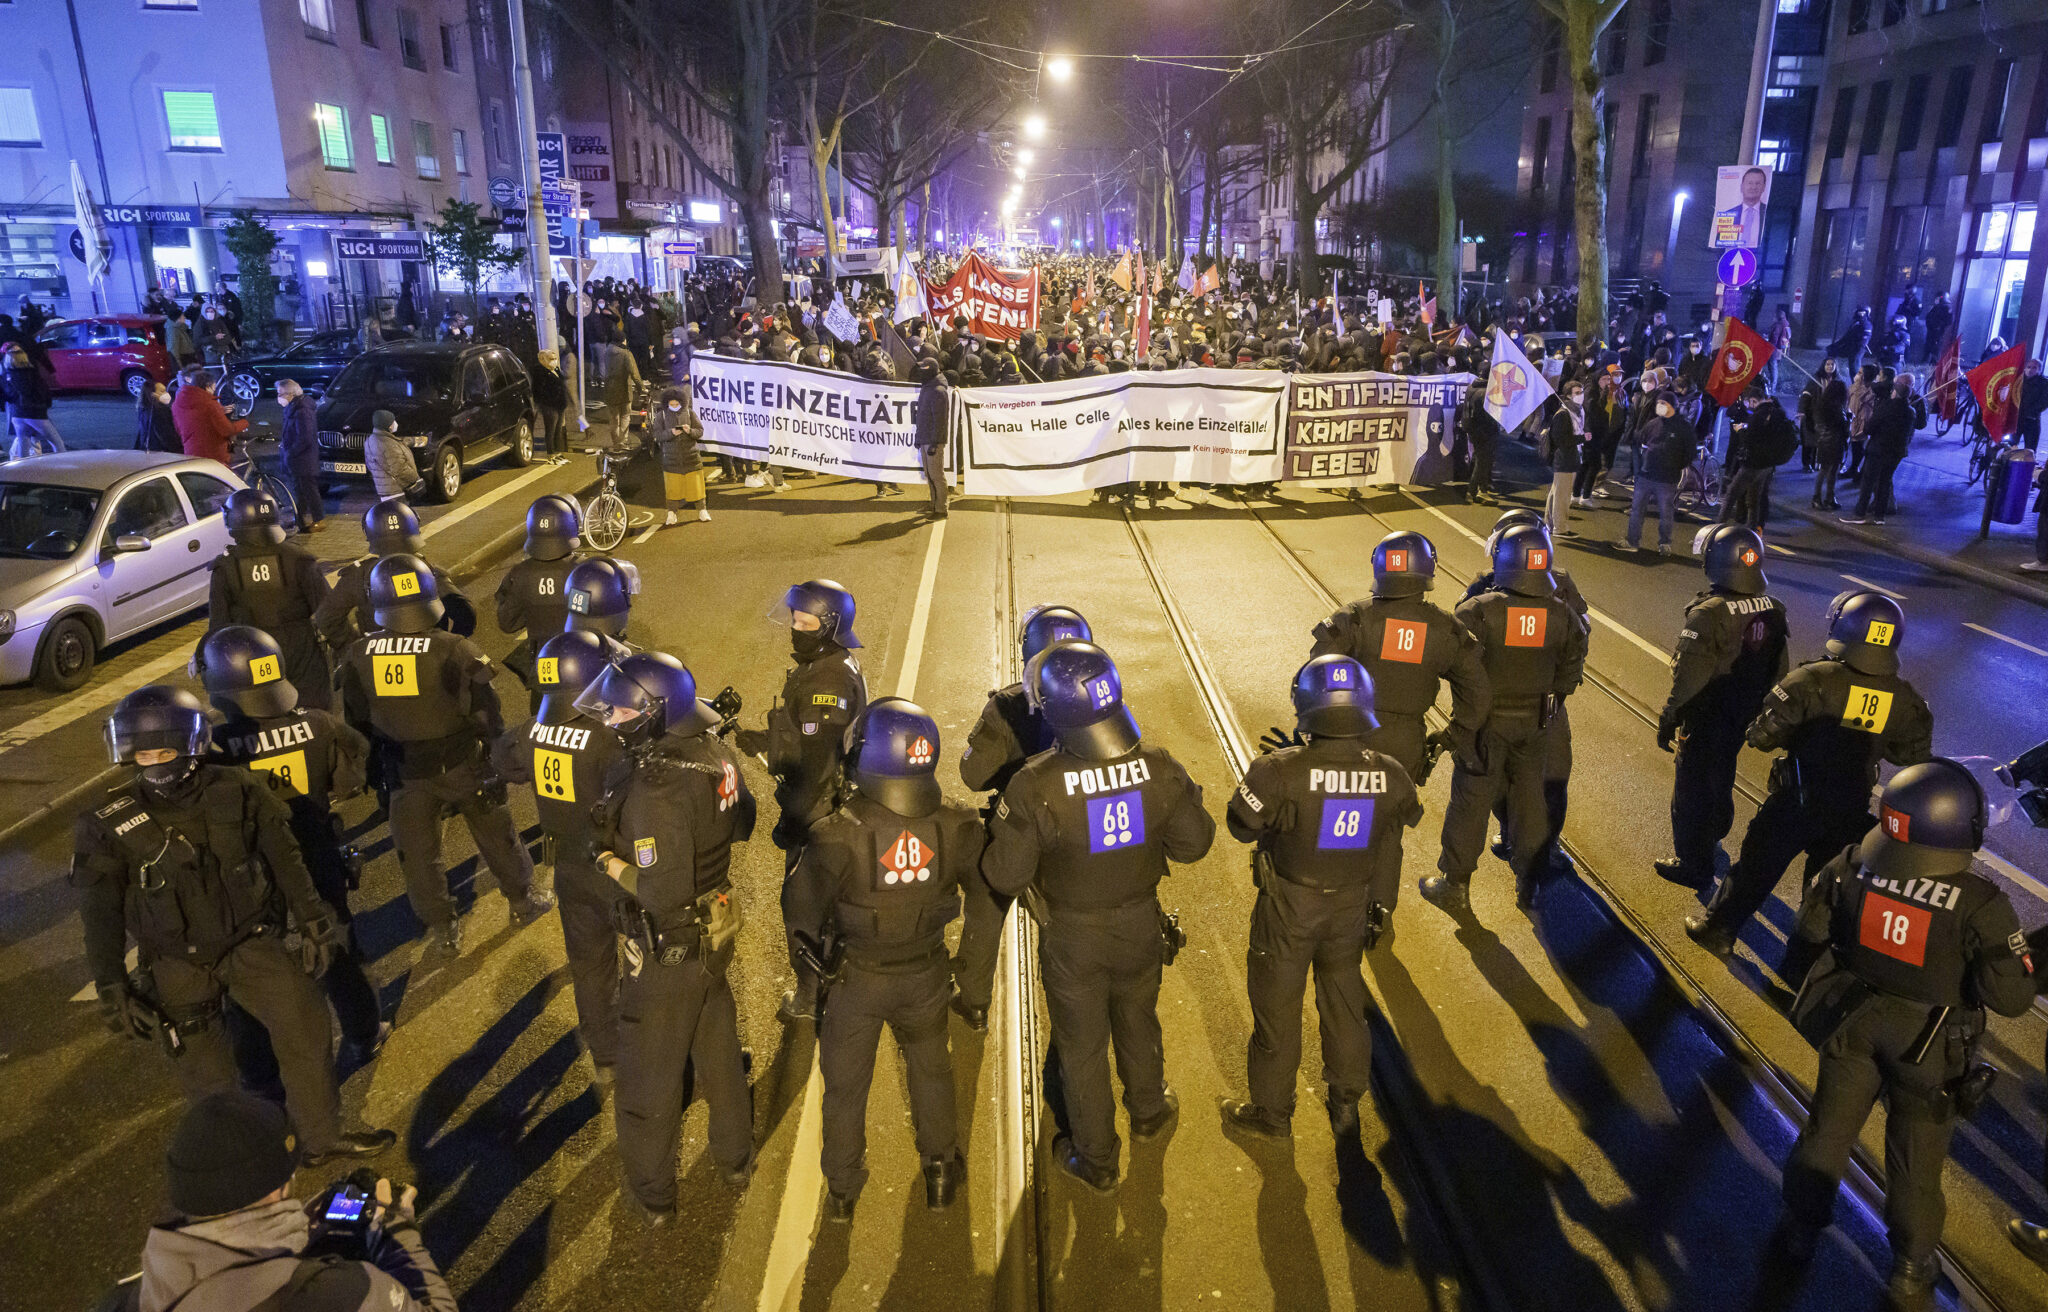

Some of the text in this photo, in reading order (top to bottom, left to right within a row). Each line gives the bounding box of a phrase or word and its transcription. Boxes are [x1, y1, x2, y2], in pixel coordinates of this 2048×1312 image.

[540, 158, 560, 192] BAR
[104, 208, 191, 222] RICH SPORTSBAR
[504, 215, 525, 227] sky
[341, 242, 419, 255] RICH SPORTSBAR
[933, 286, 964, 310] ALS
[693, 374, 755, 407] KEINE
[999, 400, 1036, 410] Vergeben
[700, 407, 737, 425] RECHTER
[772, 415, 790, 431] IST
[792, 419, 856, 442] DEUTSCHE
[978, 409, 1268, 434] Hanau Halle Celle Alles keine Einzelfälle!
[1296, 417, 1406, 445] KÄMPFEN
[792, 448, 839, 466] Frankfurt
[1193, 444, 1211, 452] Kein
[1293, 449, 1378, 477] LEBEN
[260, 504, 270, 514] 68
[388, 515, 398, 525] 68
[540, 518, 549, 529] 68
[1392, 554, 1401, 566] 18
[1533, 554, 1543, 565] 18
[1747, 552, 1755, 562] 18
[252, 564, 270, 582] 68
[401, 578, 413, 590] 68
[538, 578, 555, 595] 68
[573, 594, 583, 605] 68
[1726, 596, 1773, 615] POLIZEI
[1519, 615, 1536, 636] 18
[1751, 621, 1764, 640] 18
[1877, 625, 1887, 637] 18
[365, 637, 431, 655] POLIZEI
[1397, 628, 1415, 651] 18
[259, 662, 272, 677] 68
[385, 664, 404, 685] 68
[542, 661, 551, 674] 68
[1333, 669, 1347, 682] 68
[1096, 680, 1111, 698] 68
[817, 696, 834, 704] BFE
[1861, 693, 1879, 716] 18
[529, 722, 591, 750] POLIZEI
[915, 739, 928, 756] 68
[268, 765, 292, 791] 68
[543, 756, 561, 782] 68
[1064, 758, 1151, 796] POLIZEI
[1310, 768, 1387, 794] POLIZEI
[115, 812, 150, 836] POLIZEI
[1103, 801, 1130, 833] 68
[1333, 810, 1360, 837] 68
[1888, 815, 1899, 833] 18
[894, 837, 921, 869] 68
[1882, 910, 1909, 946] 18
